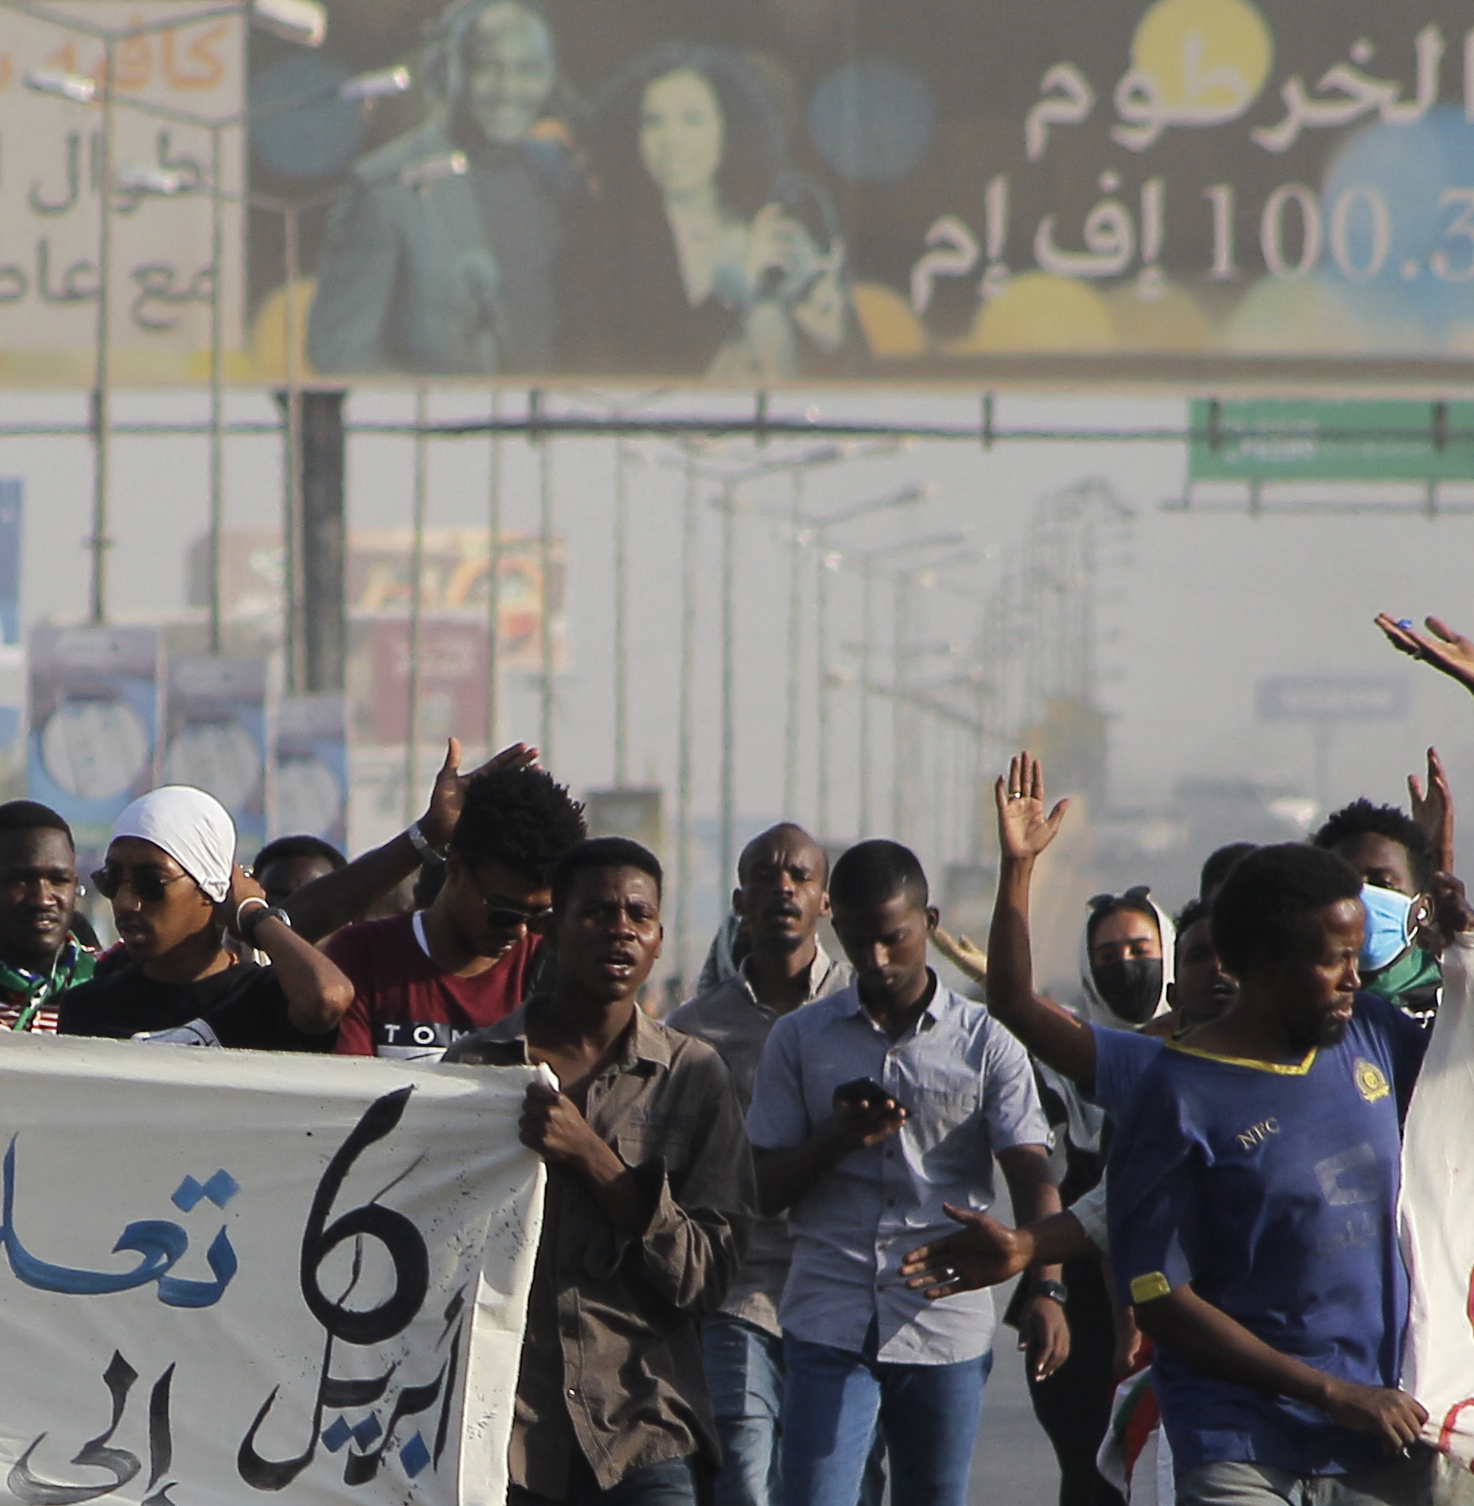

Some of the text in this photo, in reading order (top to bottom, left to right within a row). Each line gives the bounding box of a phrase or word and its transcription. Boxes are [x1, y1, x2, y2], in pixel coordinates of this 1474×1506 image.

[131, 258, 219, 330] مع
[908, 173, 1010, 312] إم
[1032, 167, 1167, 300] إف
[300, 1085, 431, 1345] 6
